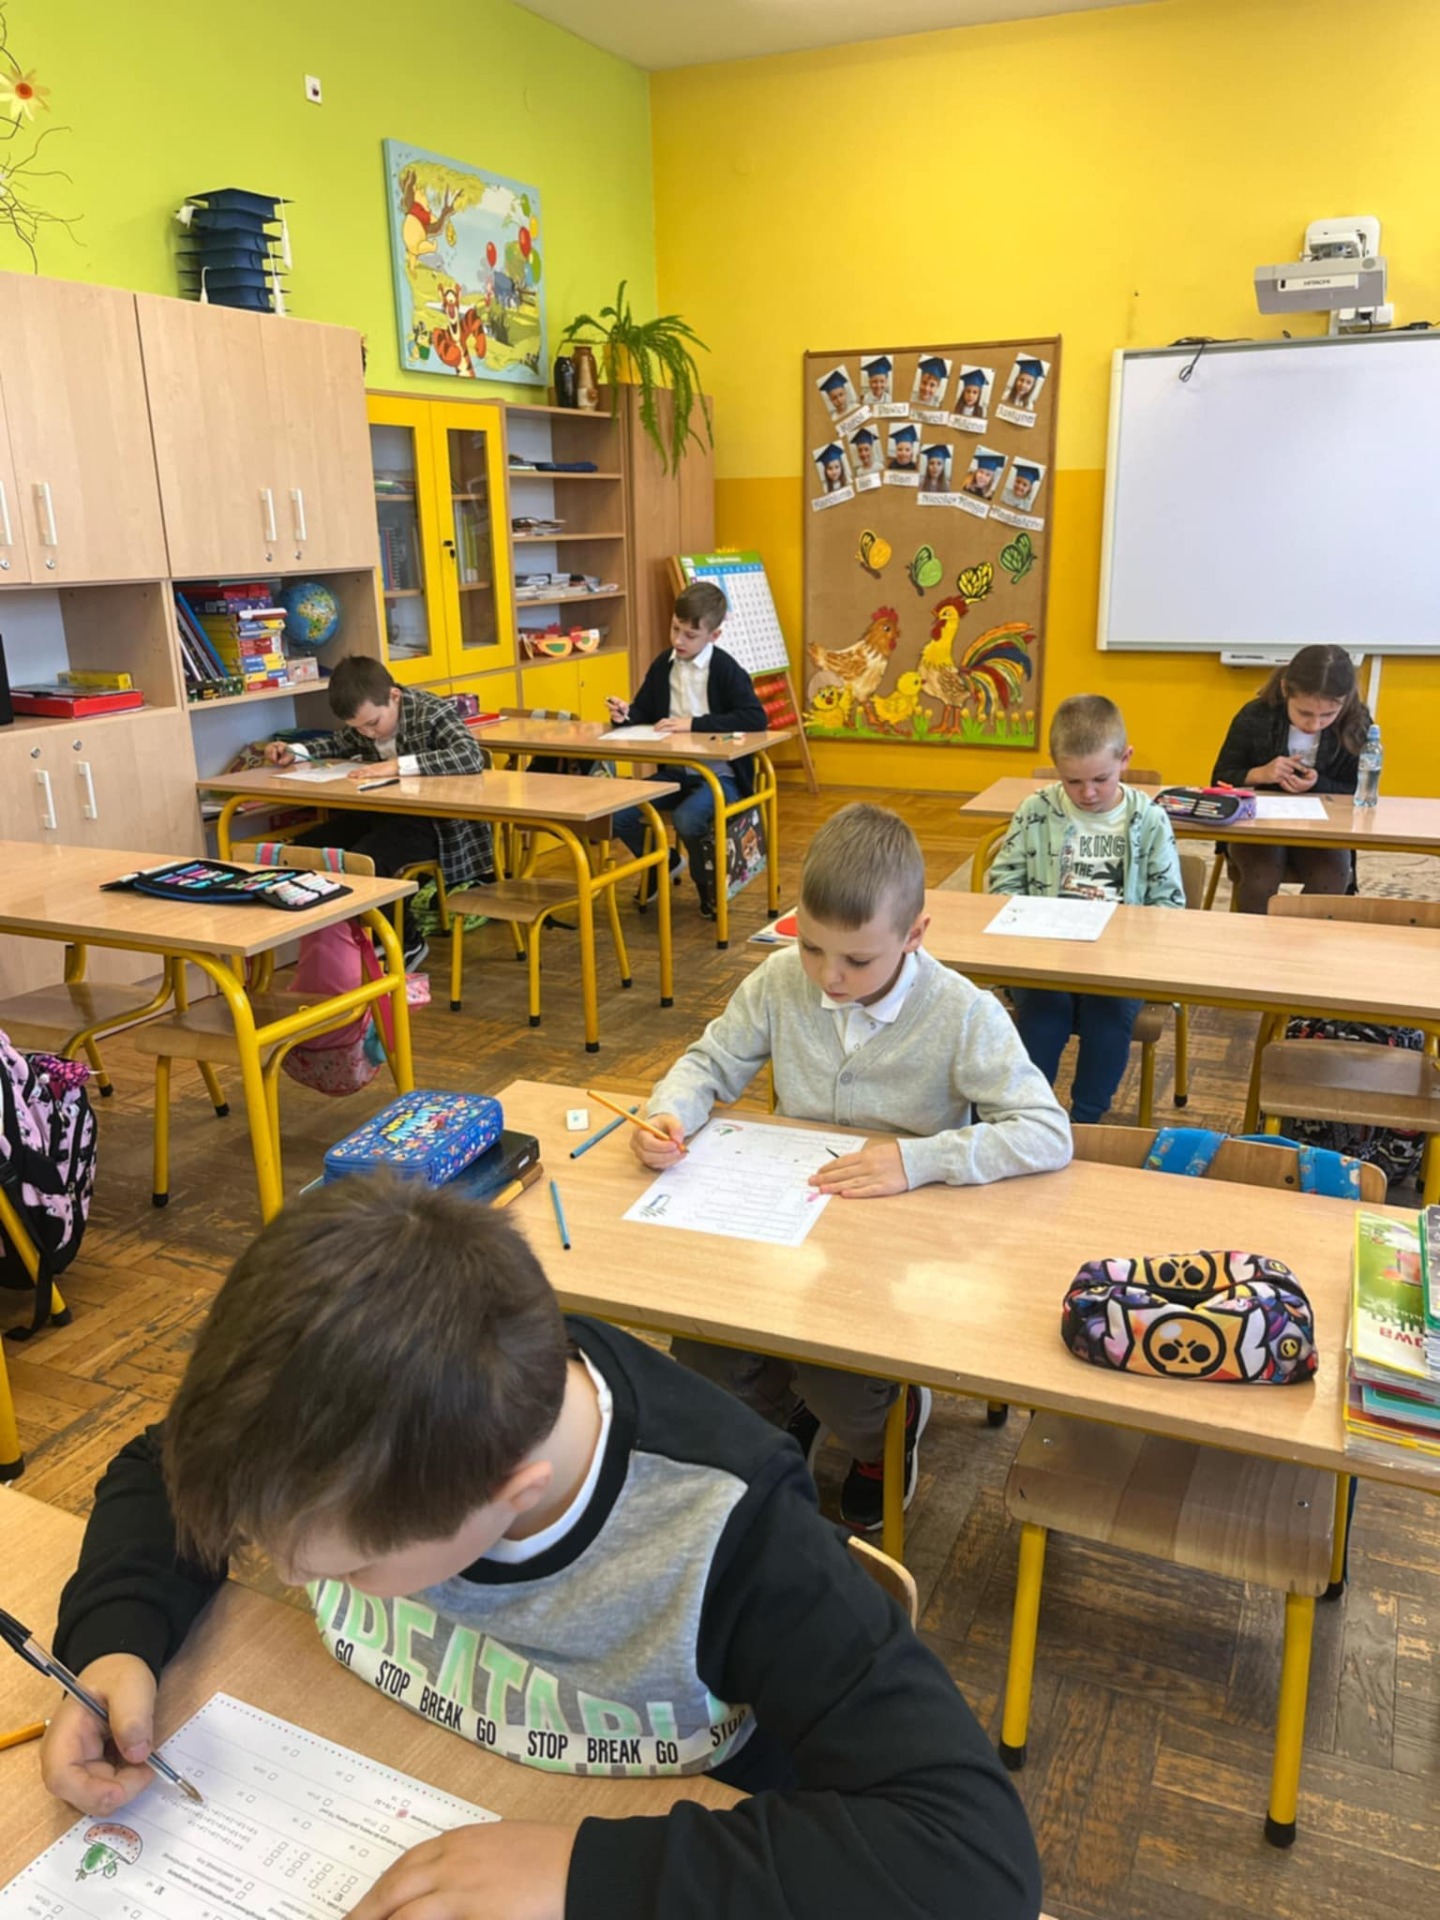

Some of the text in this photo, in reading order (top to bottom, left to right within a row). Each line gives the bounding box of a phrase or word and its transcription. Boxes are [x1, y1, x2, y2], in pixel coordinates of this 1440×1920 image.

[1079, 835, 1126, 858] KING
[1073, 862, 1095, 877] THE
[334, 1638, 355, 1667] GO
[375, 1659, 411, 1698] STOP
[419, 1685, 464, 1731] BREAK
[476, 1717, 497, 1746] GO
[527, 1730, 569, 1760] STOP
[587, 1738, 641, 1765] BREAK
[655, 1740, 679, 1764] GO
